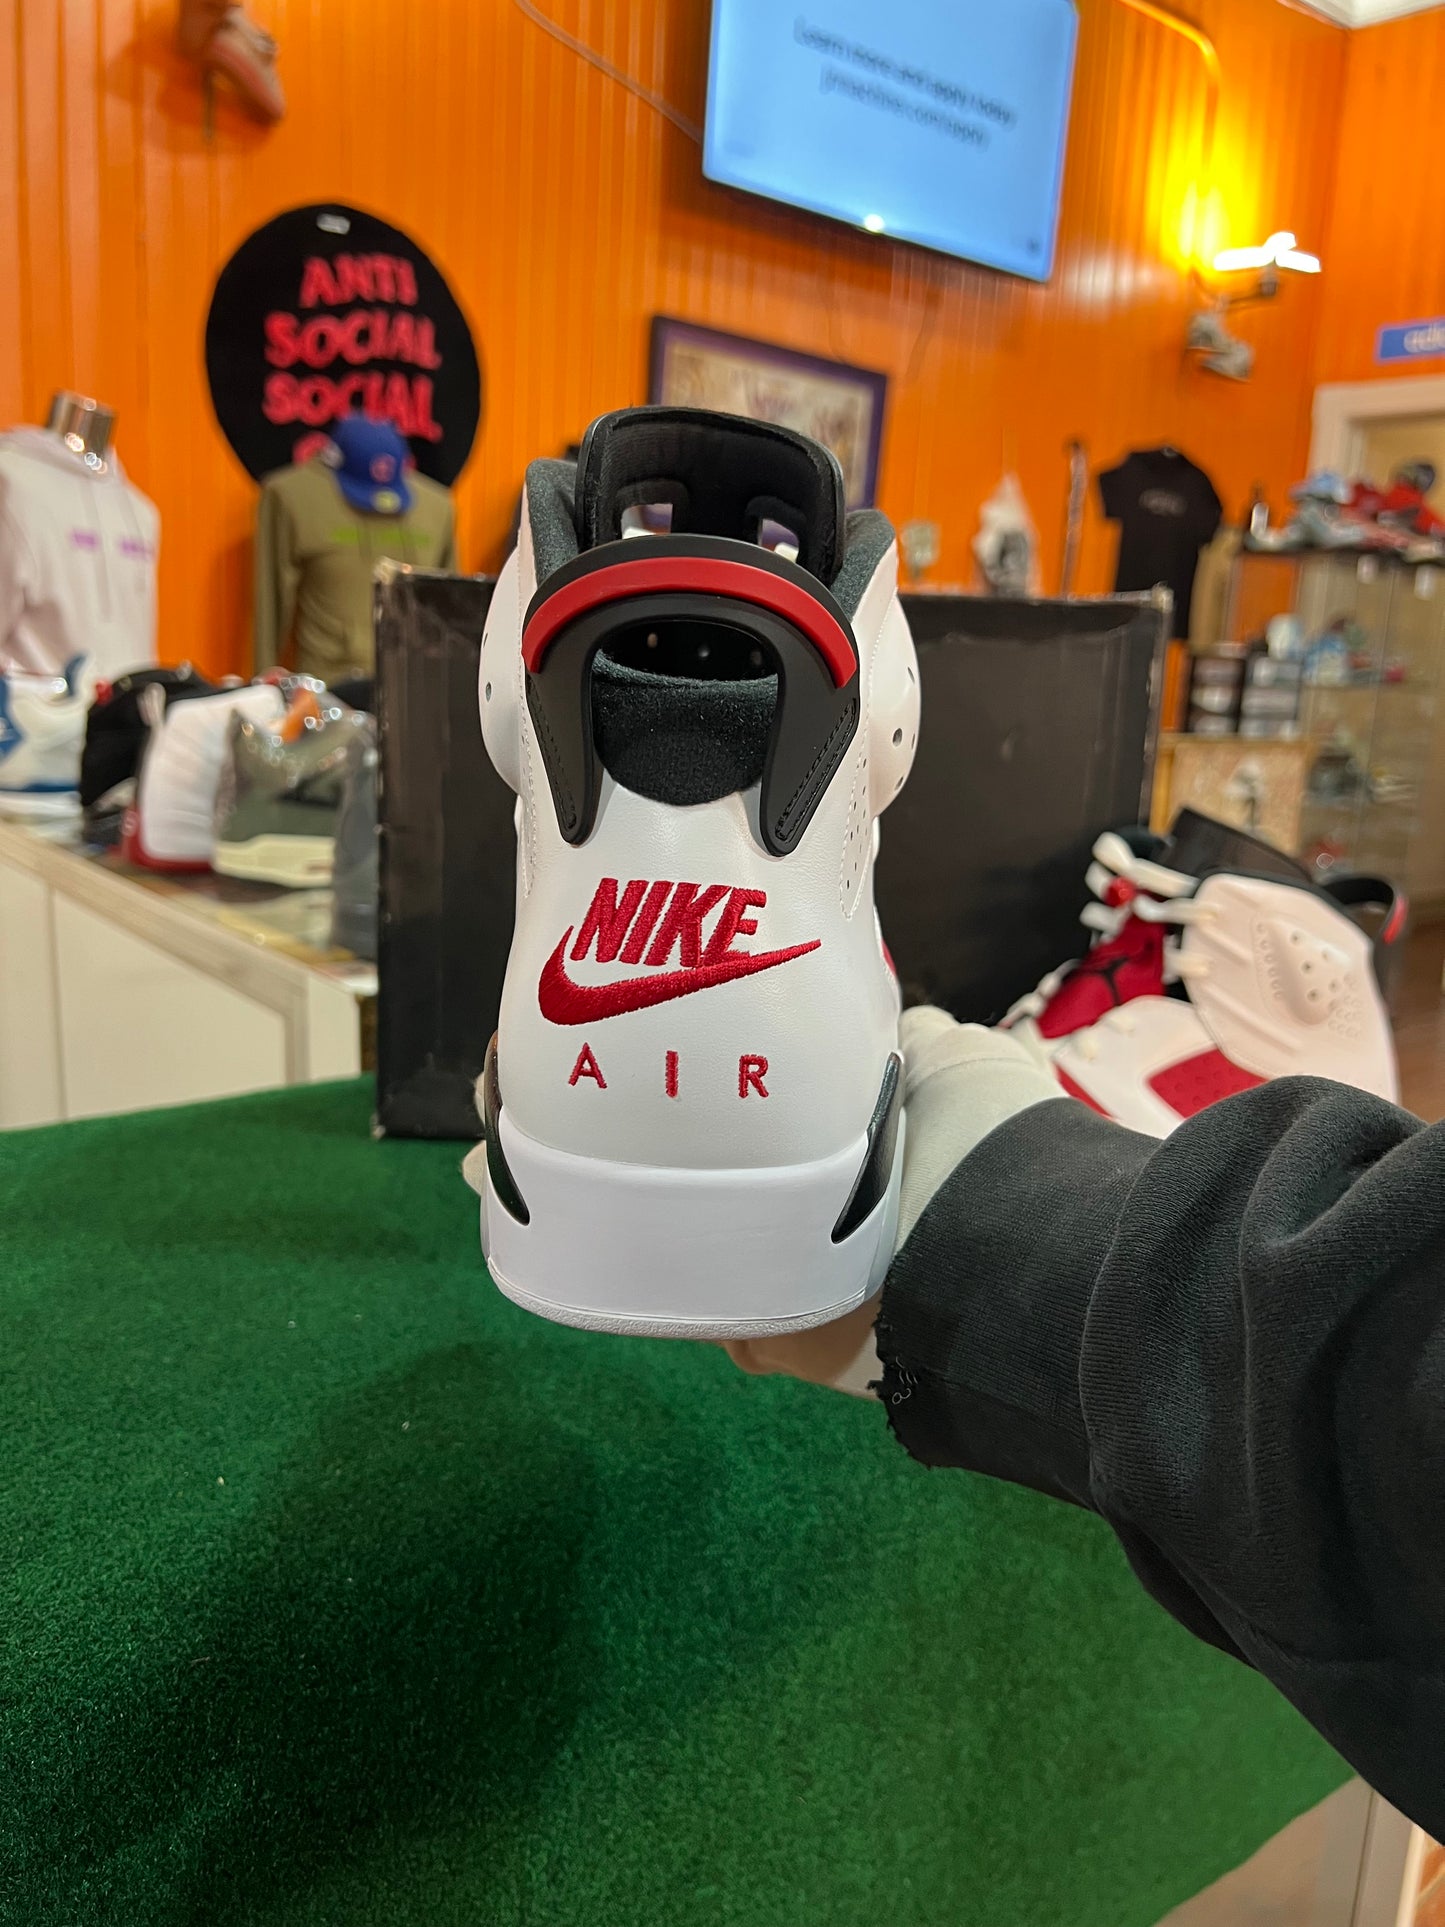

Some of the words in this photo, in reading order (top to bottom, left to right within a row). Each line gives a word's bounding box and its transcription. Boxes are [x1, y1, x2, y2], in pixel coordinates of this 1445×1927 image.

[300, 253, 417, 308] ANTI
[264, 309, 442, 370] SOCIAL
[569, 877, 767, 968] NIKE
